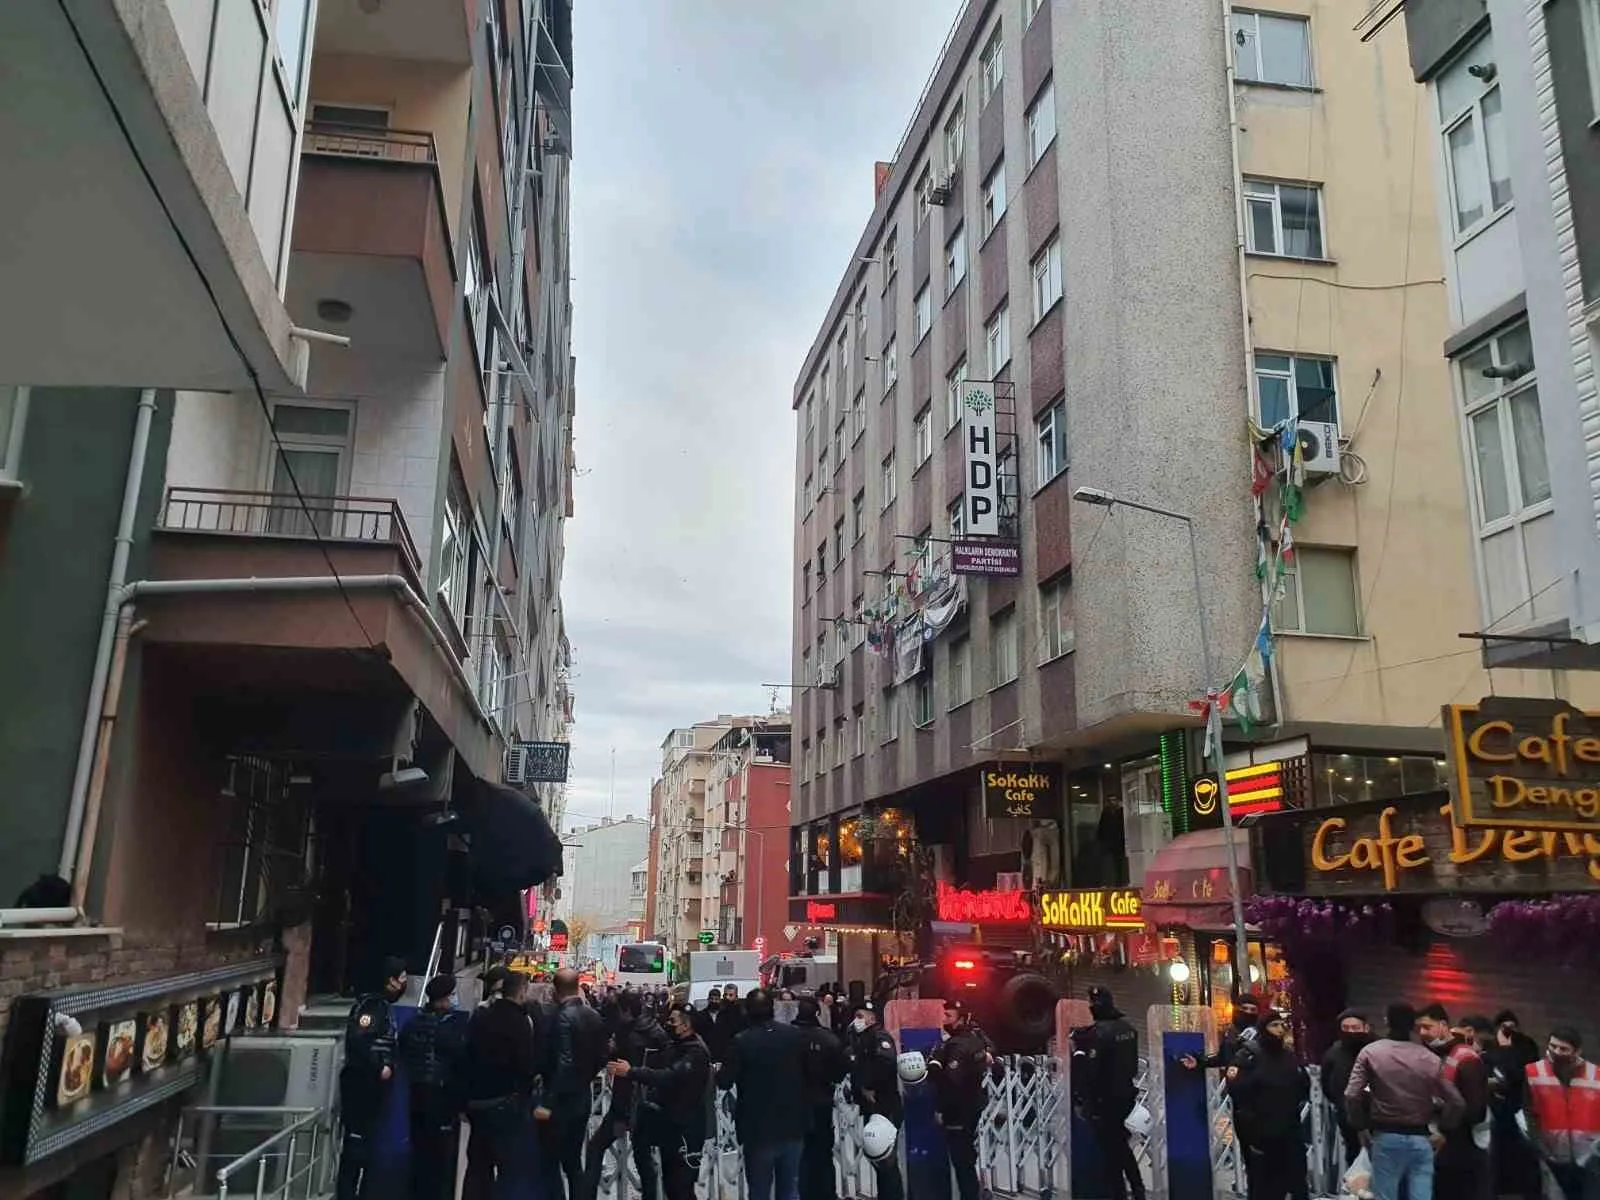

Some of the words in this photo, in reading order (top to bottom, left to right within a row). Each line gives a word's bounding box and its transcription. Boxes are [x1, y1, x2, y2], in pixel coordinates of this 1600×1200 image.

[969, 425, 992, 525] HDP
[1469, 713, 1600, 775] Cafe
[1005, 789, 1035, 801] Cafe
[1311, 807, 1430, 892] Cafe
[1110, 891, 1138, 915] Cafe
